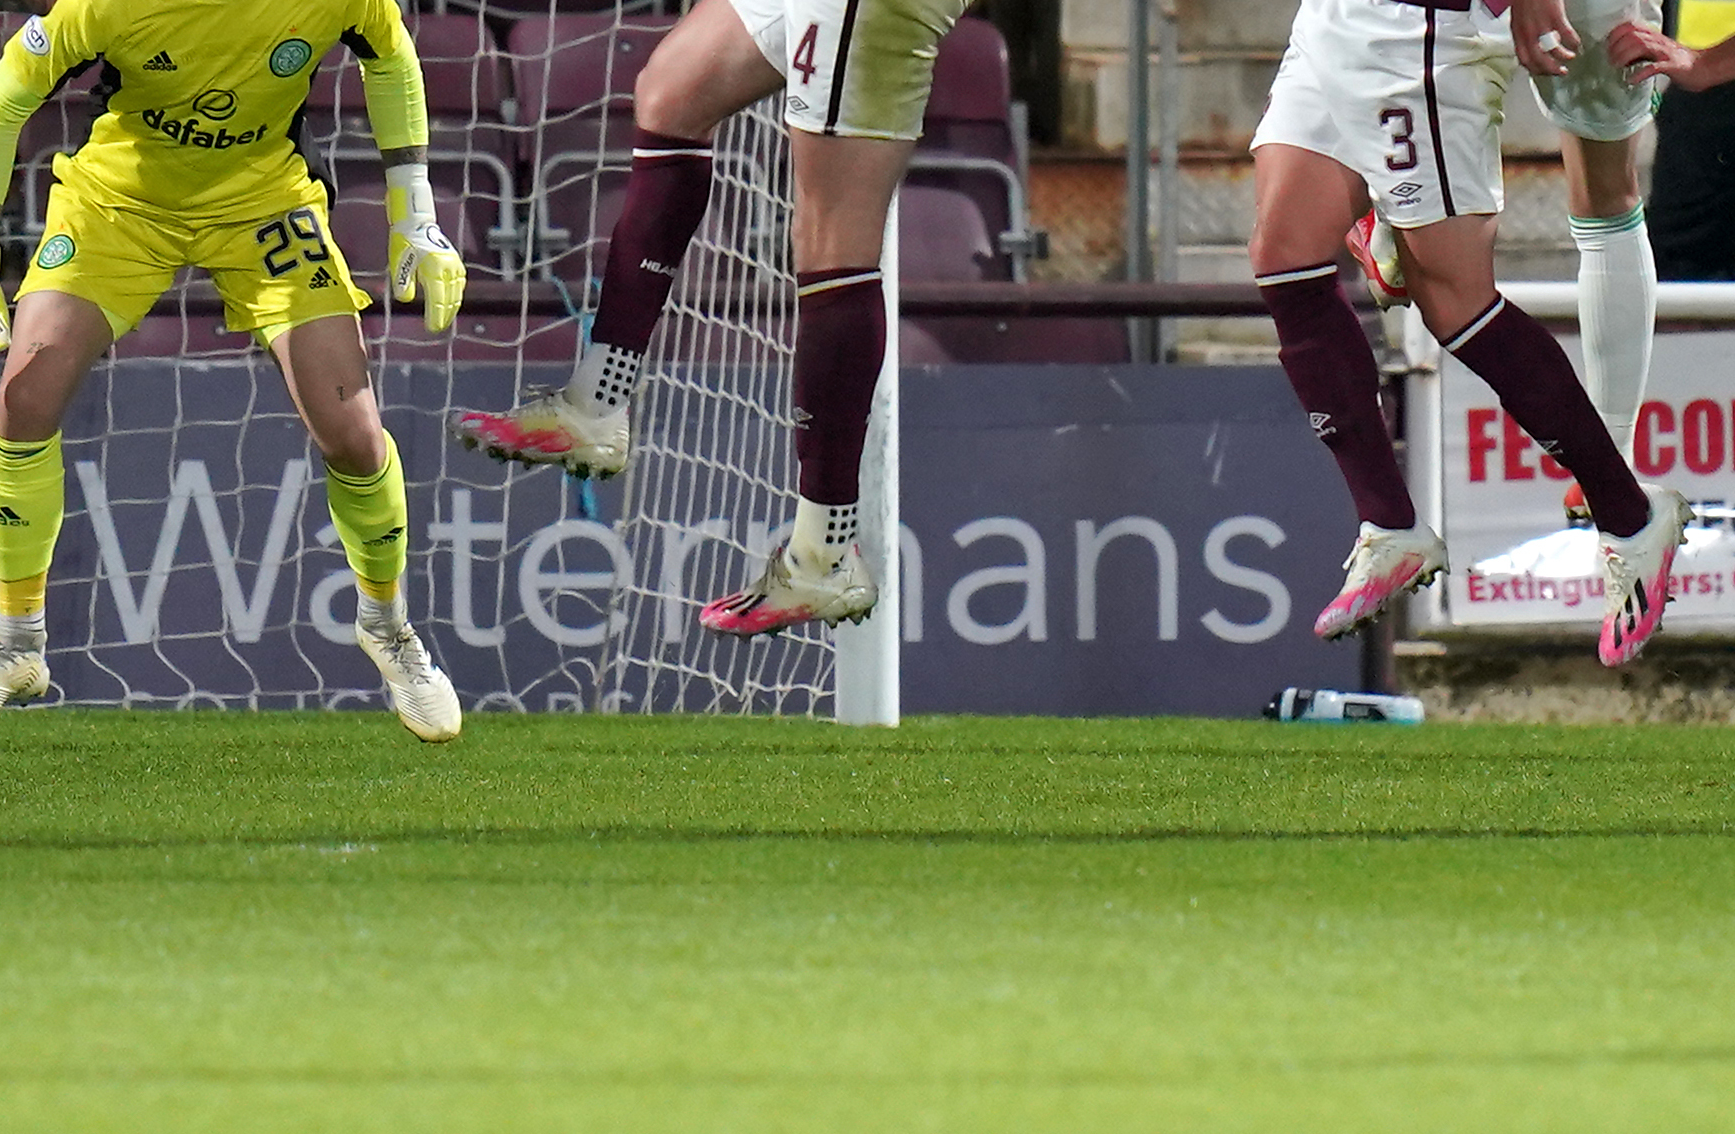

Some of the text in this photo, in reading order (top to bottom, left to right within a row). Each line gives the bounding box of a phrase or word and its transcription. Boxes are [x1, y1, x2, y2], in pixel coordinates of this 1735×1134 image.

[792, 23, 819, 85] 4
[142, 108, 270, 151] dafabet
[1379, 107, 1418, 171] 3
[256, 208, 330, 278] 29
[1632, 397, 1735, 478] CO
